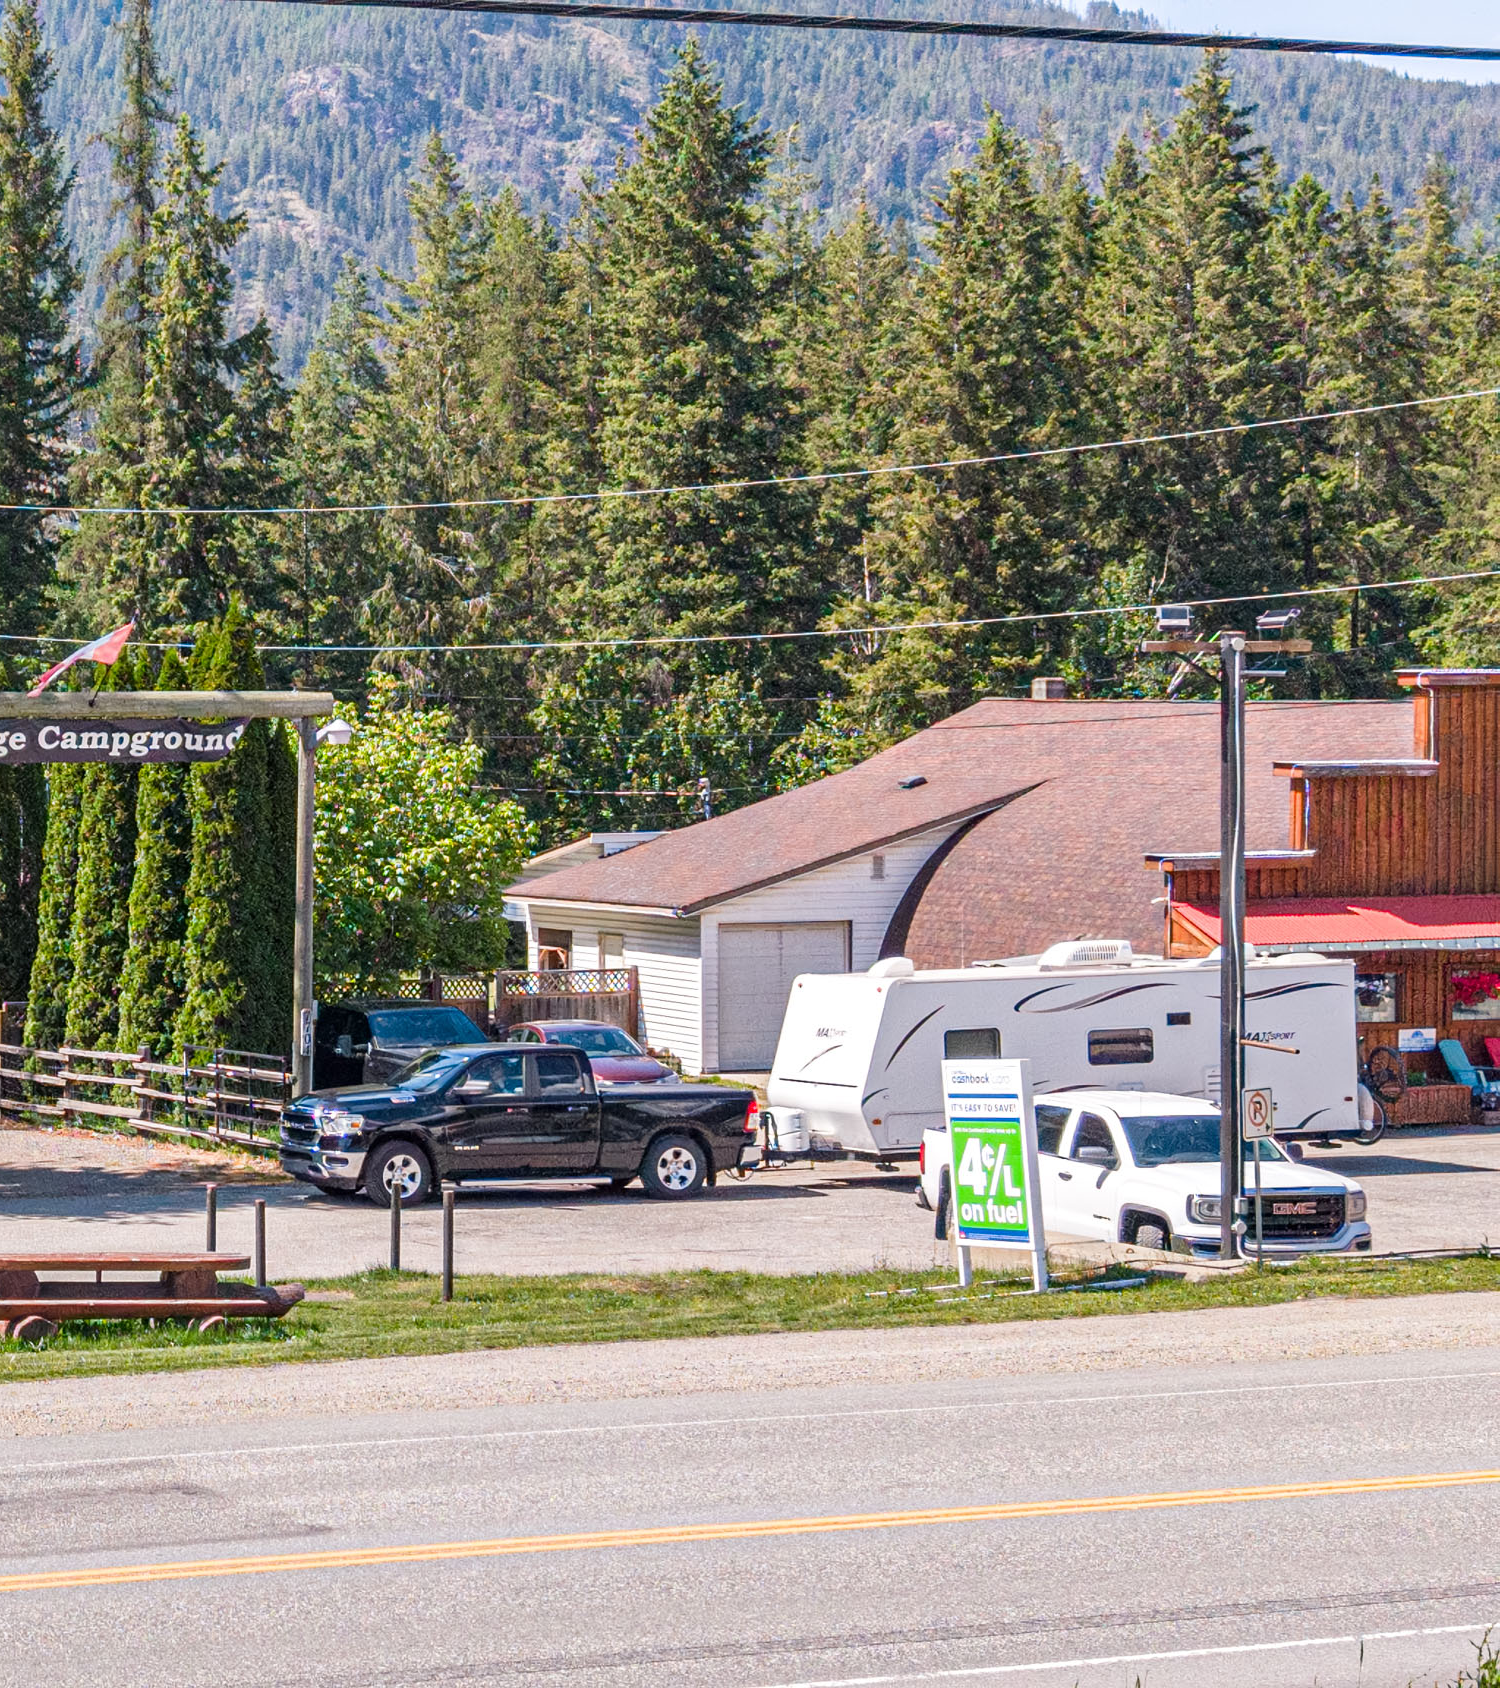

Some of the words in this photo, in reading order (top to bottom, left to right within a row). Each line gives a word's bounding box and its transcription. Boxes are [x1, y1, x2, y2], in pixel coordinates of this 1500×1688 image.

[37, 725, 244, 757] Campground
[964, 1104, 981, 1112] EASY
[984, 1104, 993, 1112] TO
[995, 1104, 1017, 1112] SAVE!
[961, 1203, 985, 1222] on
[986, 1198, 1024, 1224] fuel
[1273, 1202, 1317, 1215] GMC
